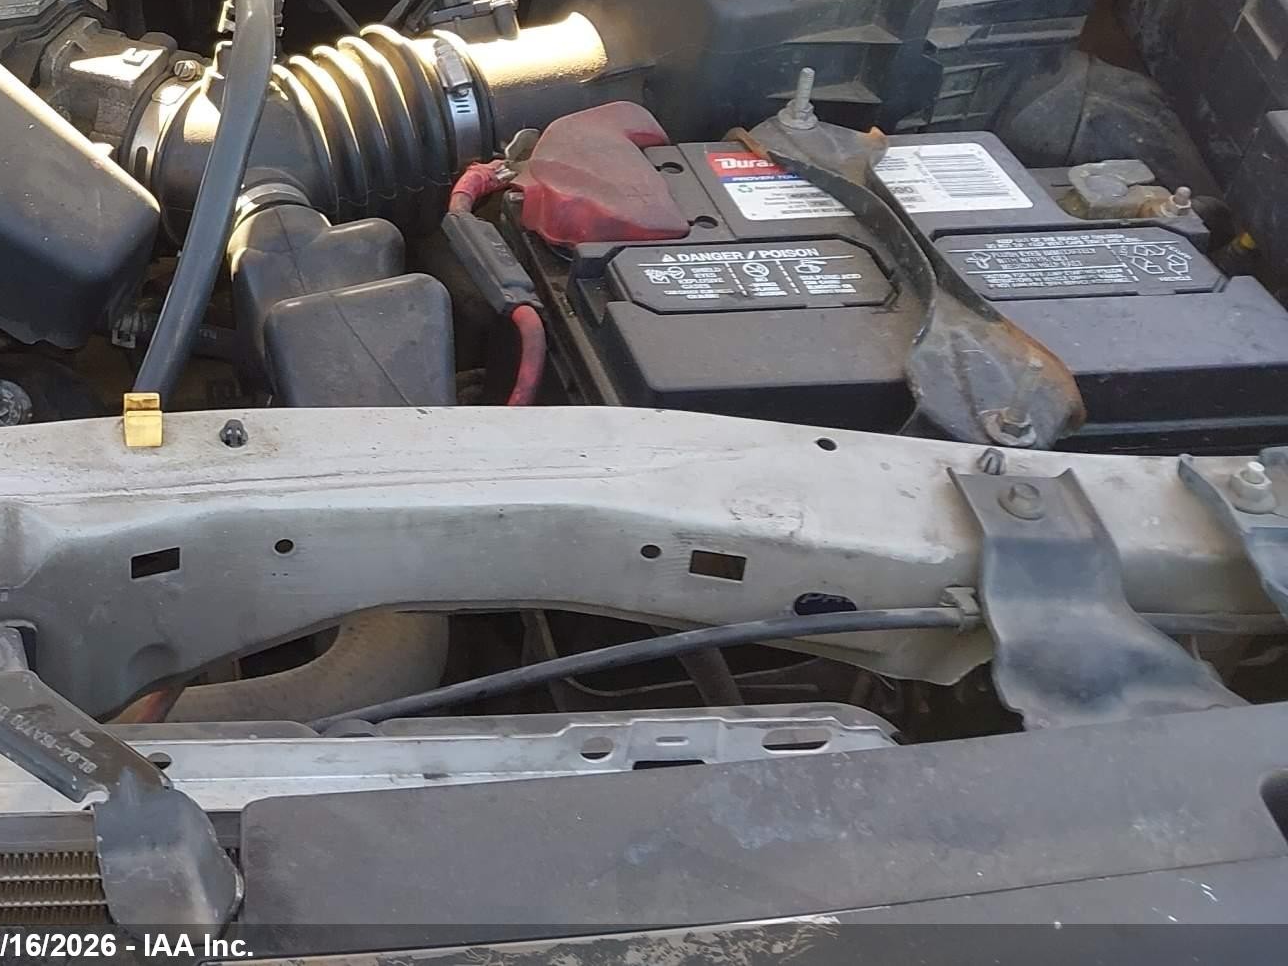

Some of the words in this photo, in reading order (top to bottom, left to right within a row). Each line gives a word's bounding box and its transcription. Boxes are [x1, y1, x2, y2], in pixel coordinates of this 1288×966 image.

[714, 158, 775, 170] Dura
[677, 251, 745, 263] DANGER
[758, 247, 820, 259] POISON
